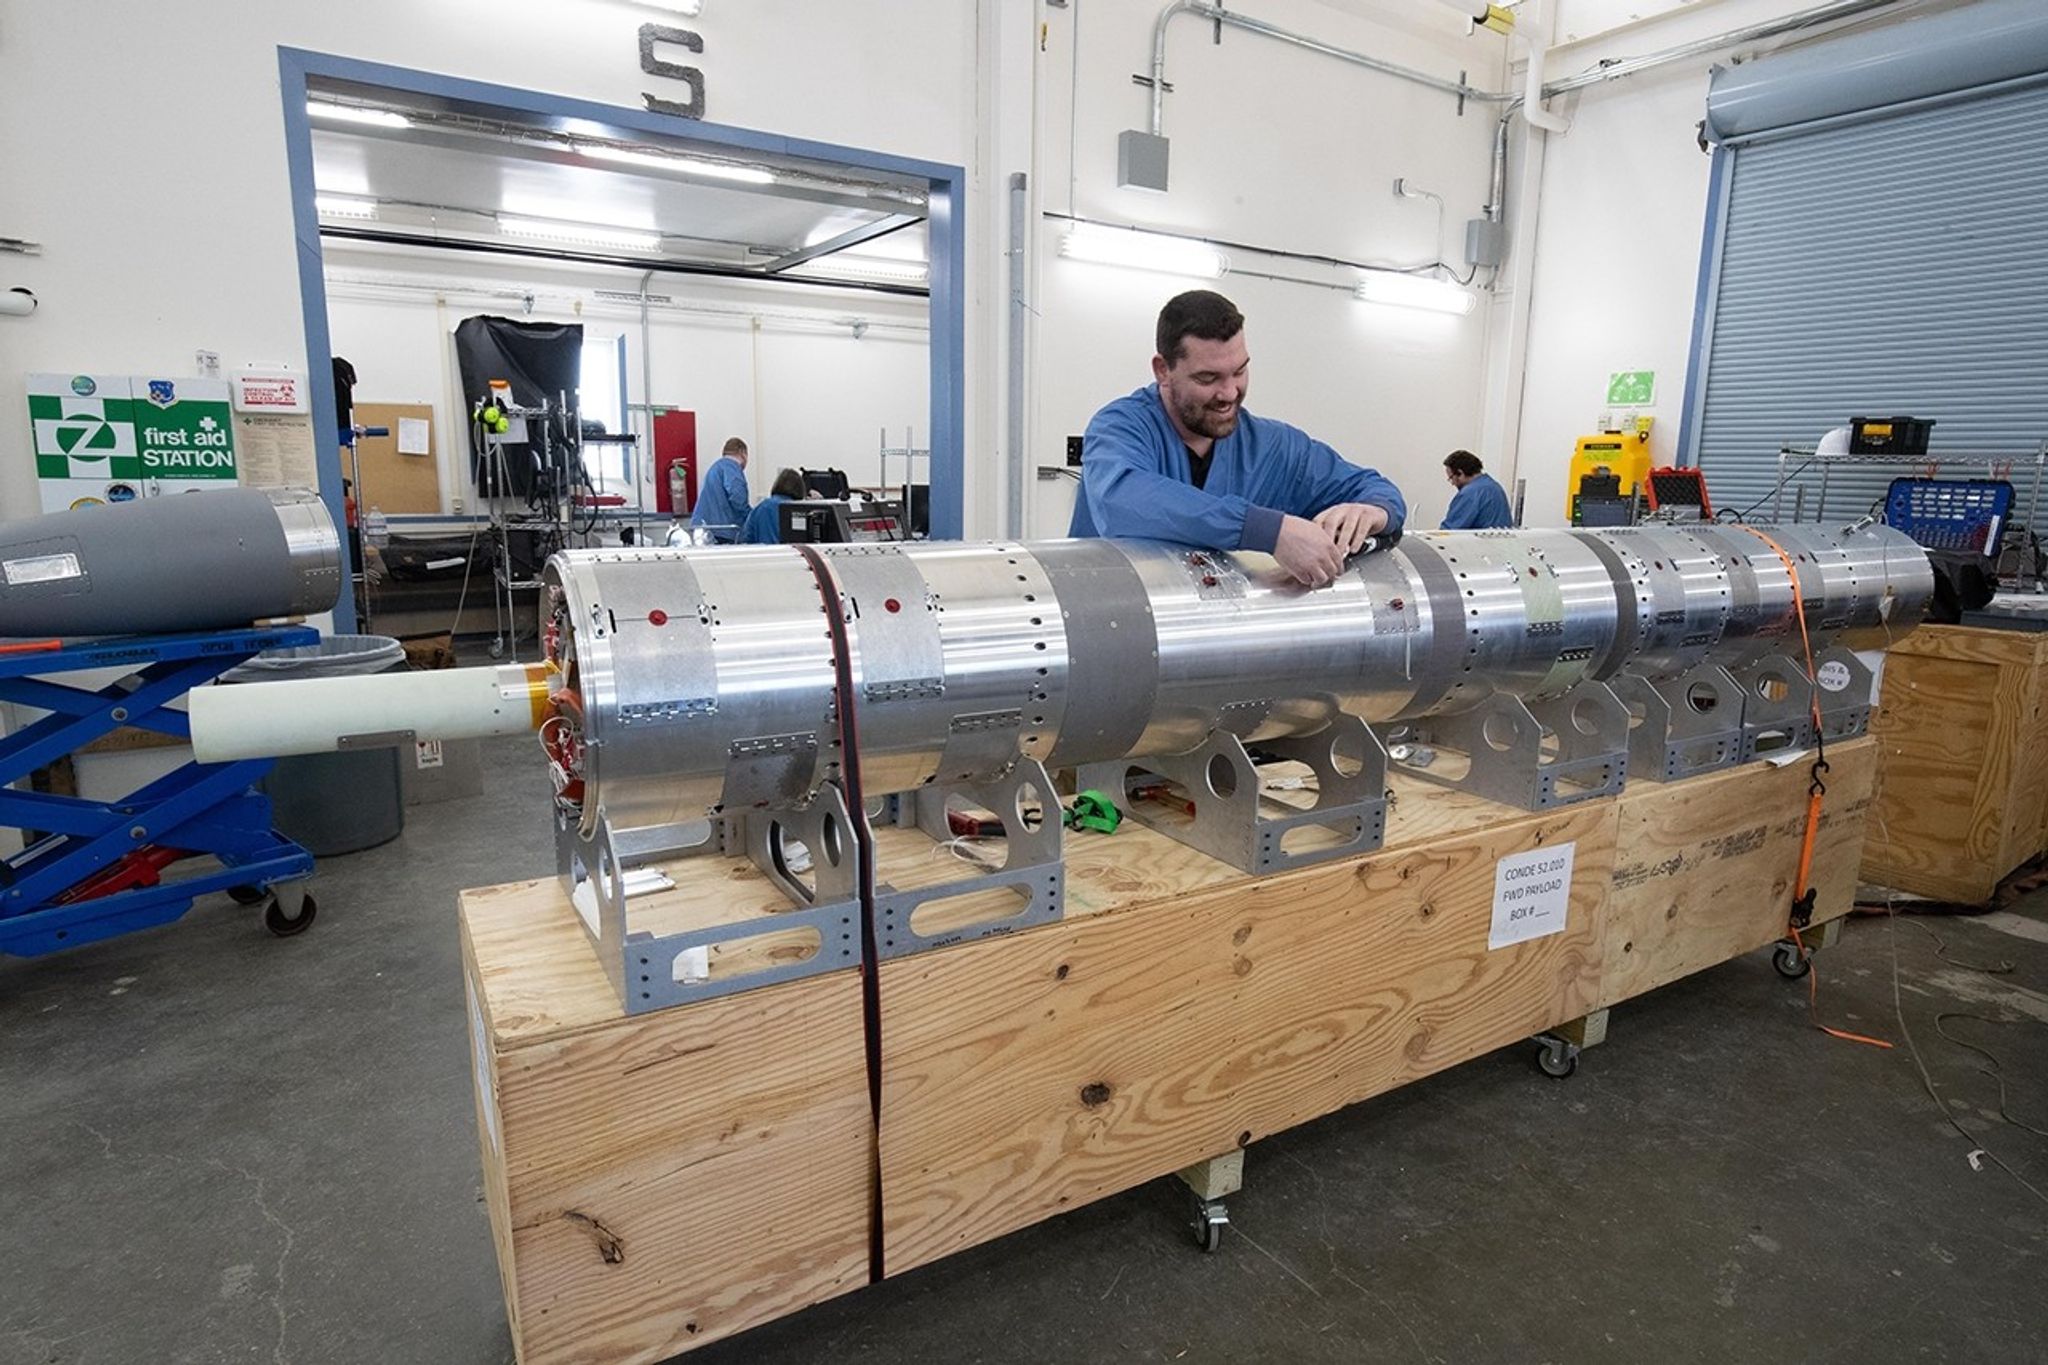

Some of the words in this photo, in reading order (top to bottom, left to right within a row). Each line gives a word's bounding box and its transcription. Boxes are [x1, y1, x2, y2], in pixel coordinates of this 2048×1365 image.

[638, 22, 705, 120] S
[143, 427, 189, 446] first
[194, 428, 227, 446] aid
[143, 449, 233, 467] STATION
[1505, 864, 1536, 881] CONDE
[1503, 887, 1524, 902] FWD
[1525, 879, 1562, 897] PAYLOAD
[1510, 906, 1528, 921] BOX
